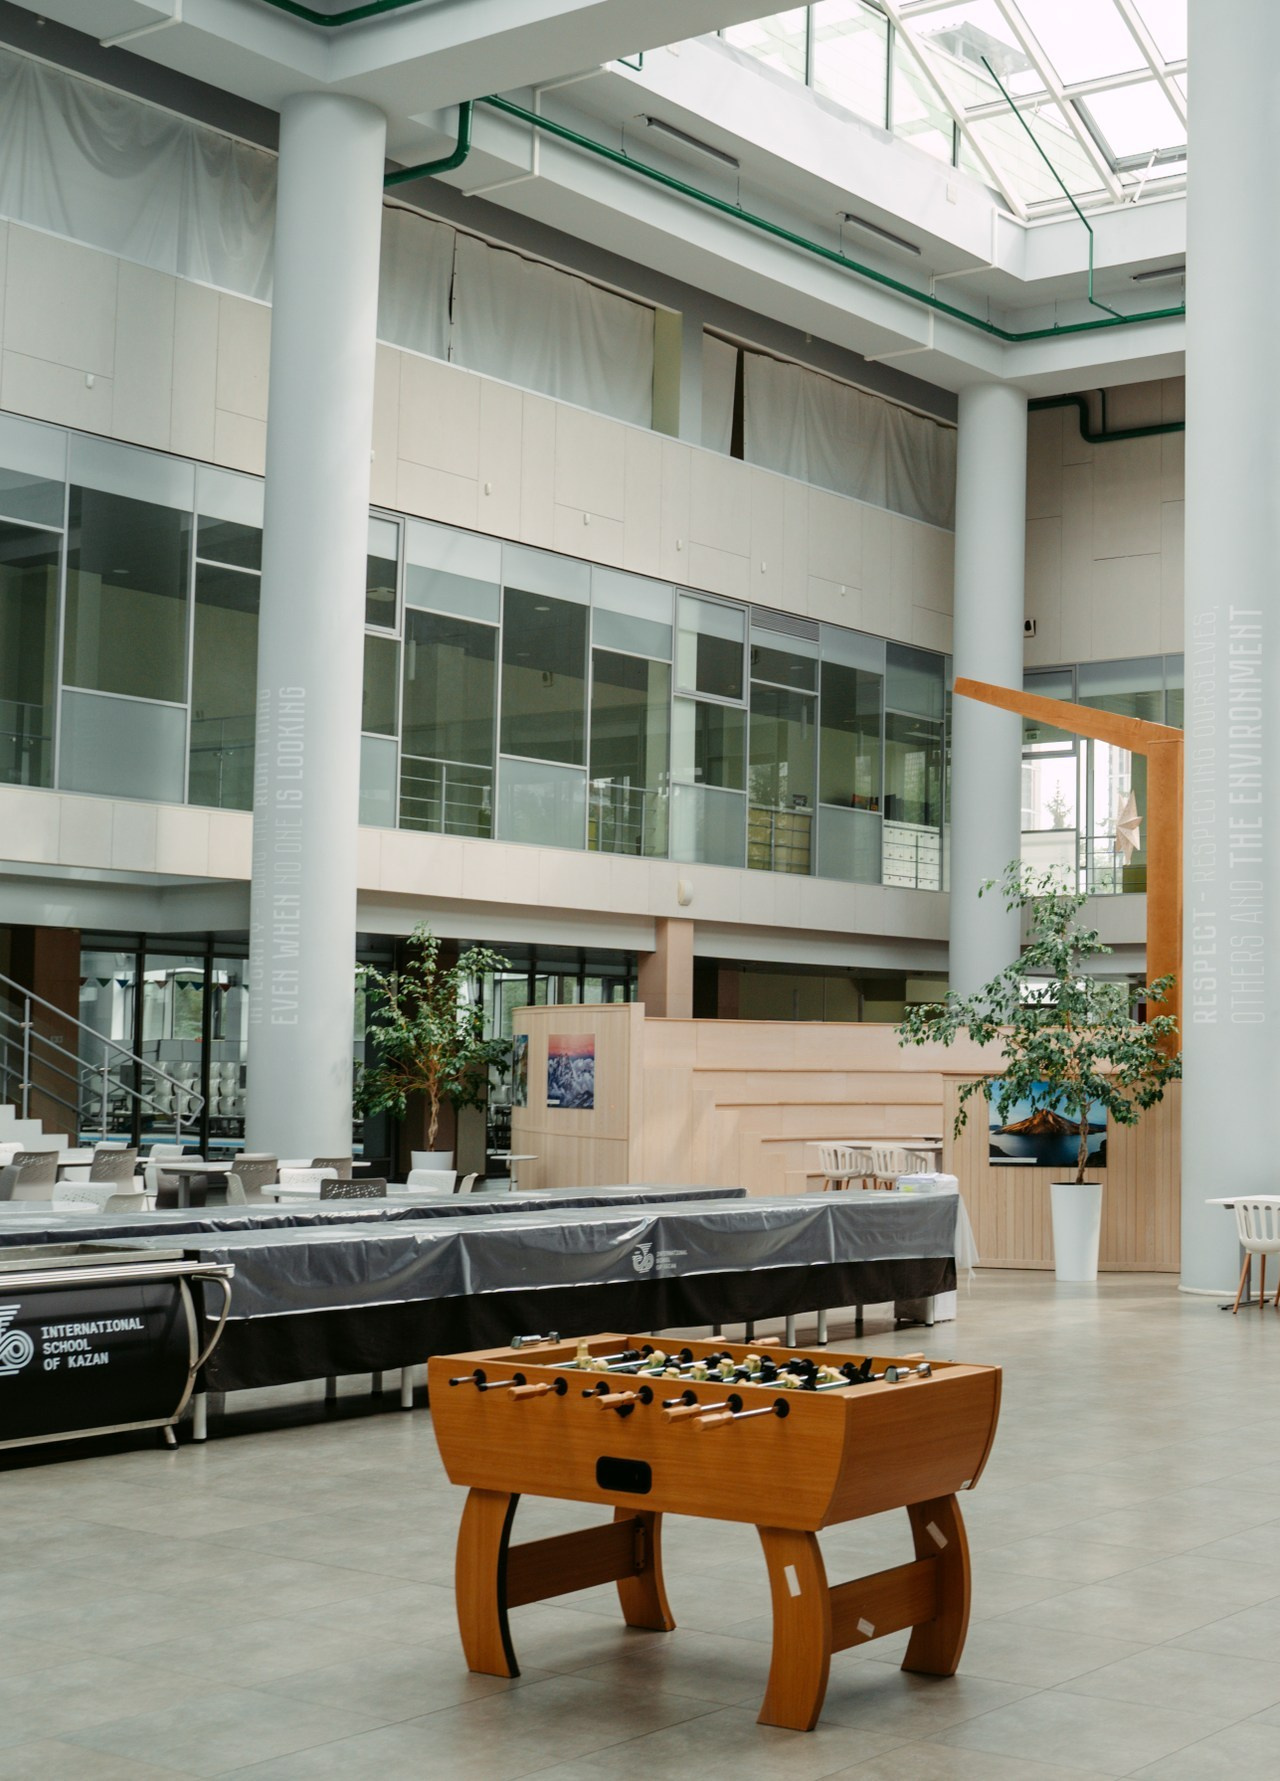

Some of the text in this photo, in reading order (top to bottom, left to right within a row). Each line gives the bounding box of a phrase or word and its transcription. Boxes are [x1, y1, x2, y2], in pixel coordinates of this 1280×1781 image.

[1192, 605, 1220, 738] OURSELVES,
[272, 687, 305, 1024] EVEN WHEN NO ONE IS LOOKING
[1192, 747, 1217, 883] RESPECTING
[1228, 604, 1265, 1024] OTHERS AND THE ENVIRONMENT
[1193, 906, 1217, 1024] RESPECT
[40, 1317, 145, 1338] INTERNATIONAL
[42, 1338, 92, 1355] SCHOOL
[43, 1352, 109, 1371] OF KAZAN
